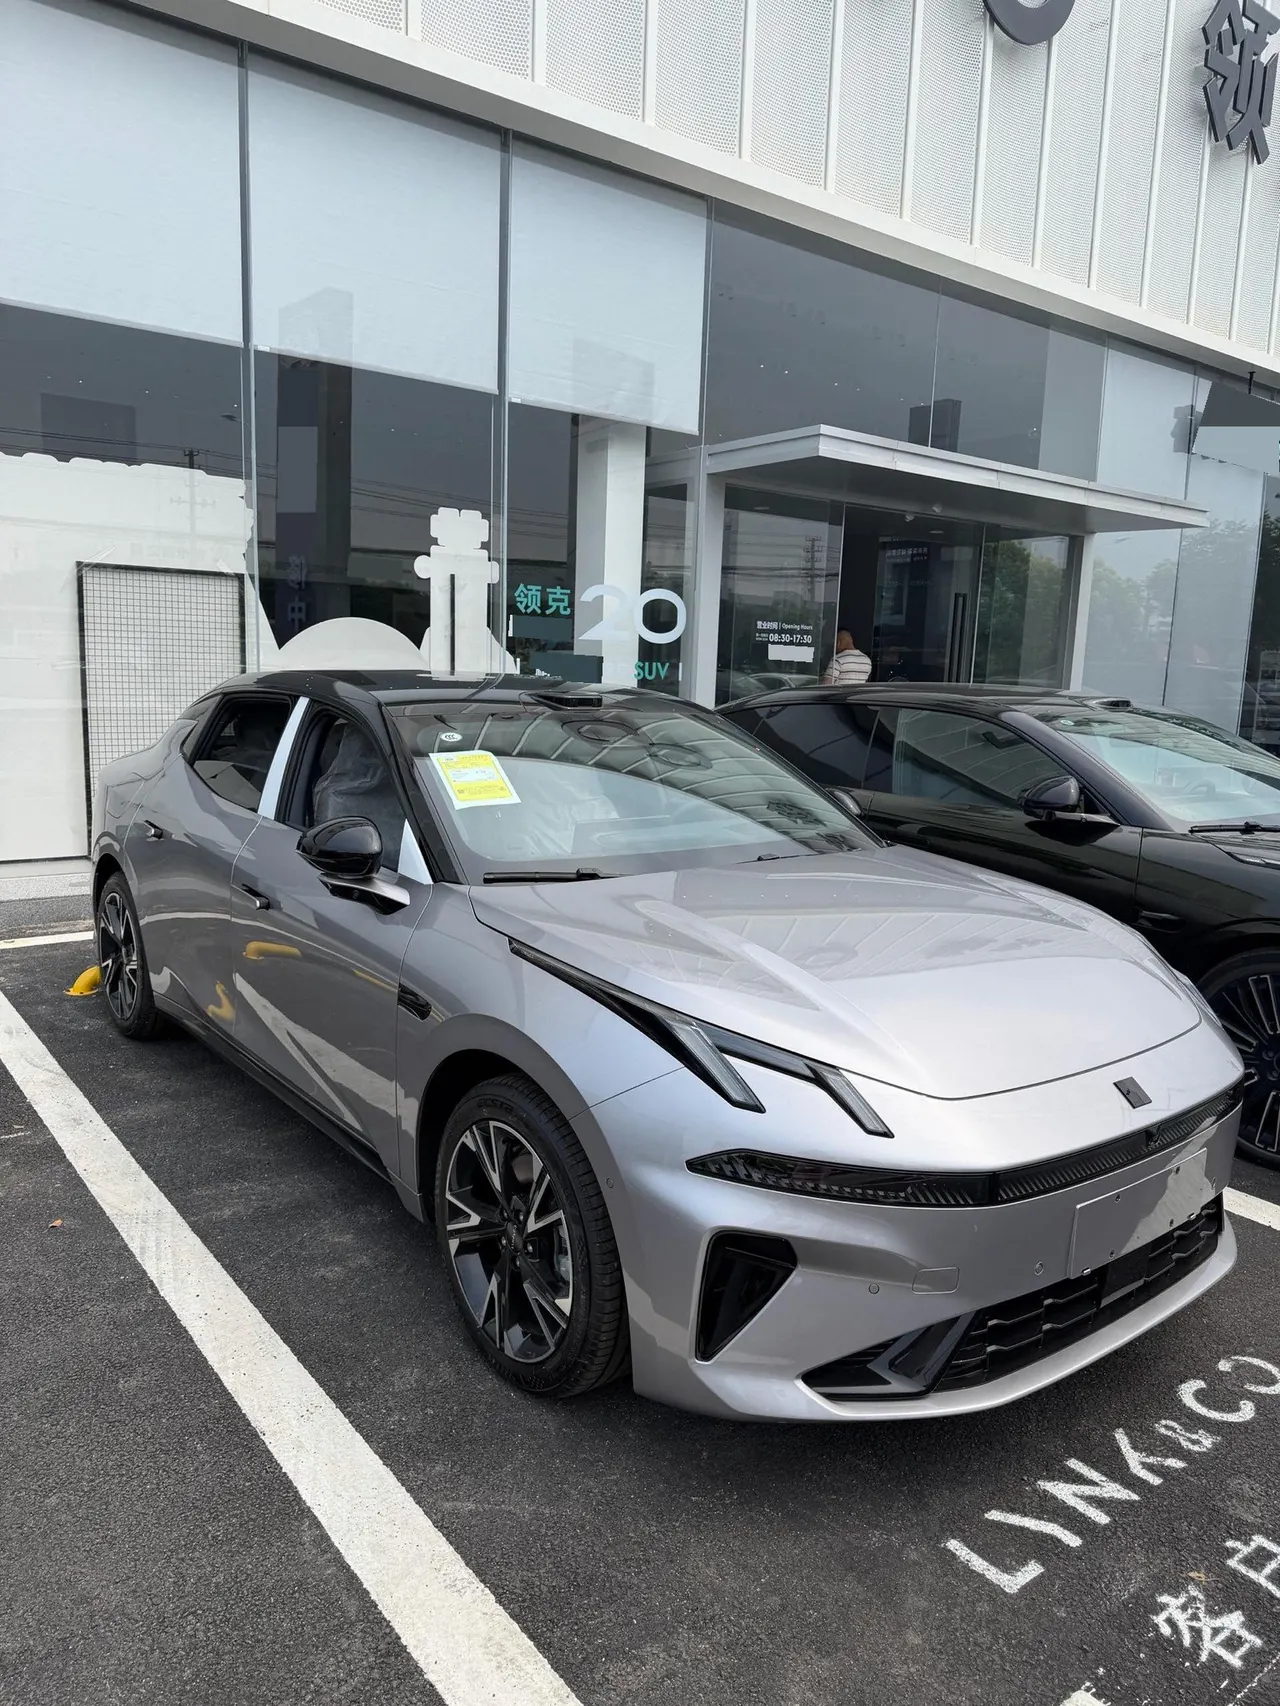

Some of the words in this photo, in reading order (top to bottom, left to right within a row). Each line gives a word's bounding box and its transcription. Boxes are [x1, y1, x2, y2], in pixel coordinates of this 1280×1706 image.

[514, 583, 571, 616] 领克
[782, 623, 800, 631] Opening
[769, 633, 812, 644] 08:30-17:30
[633, 661, 670, 681] SUV
